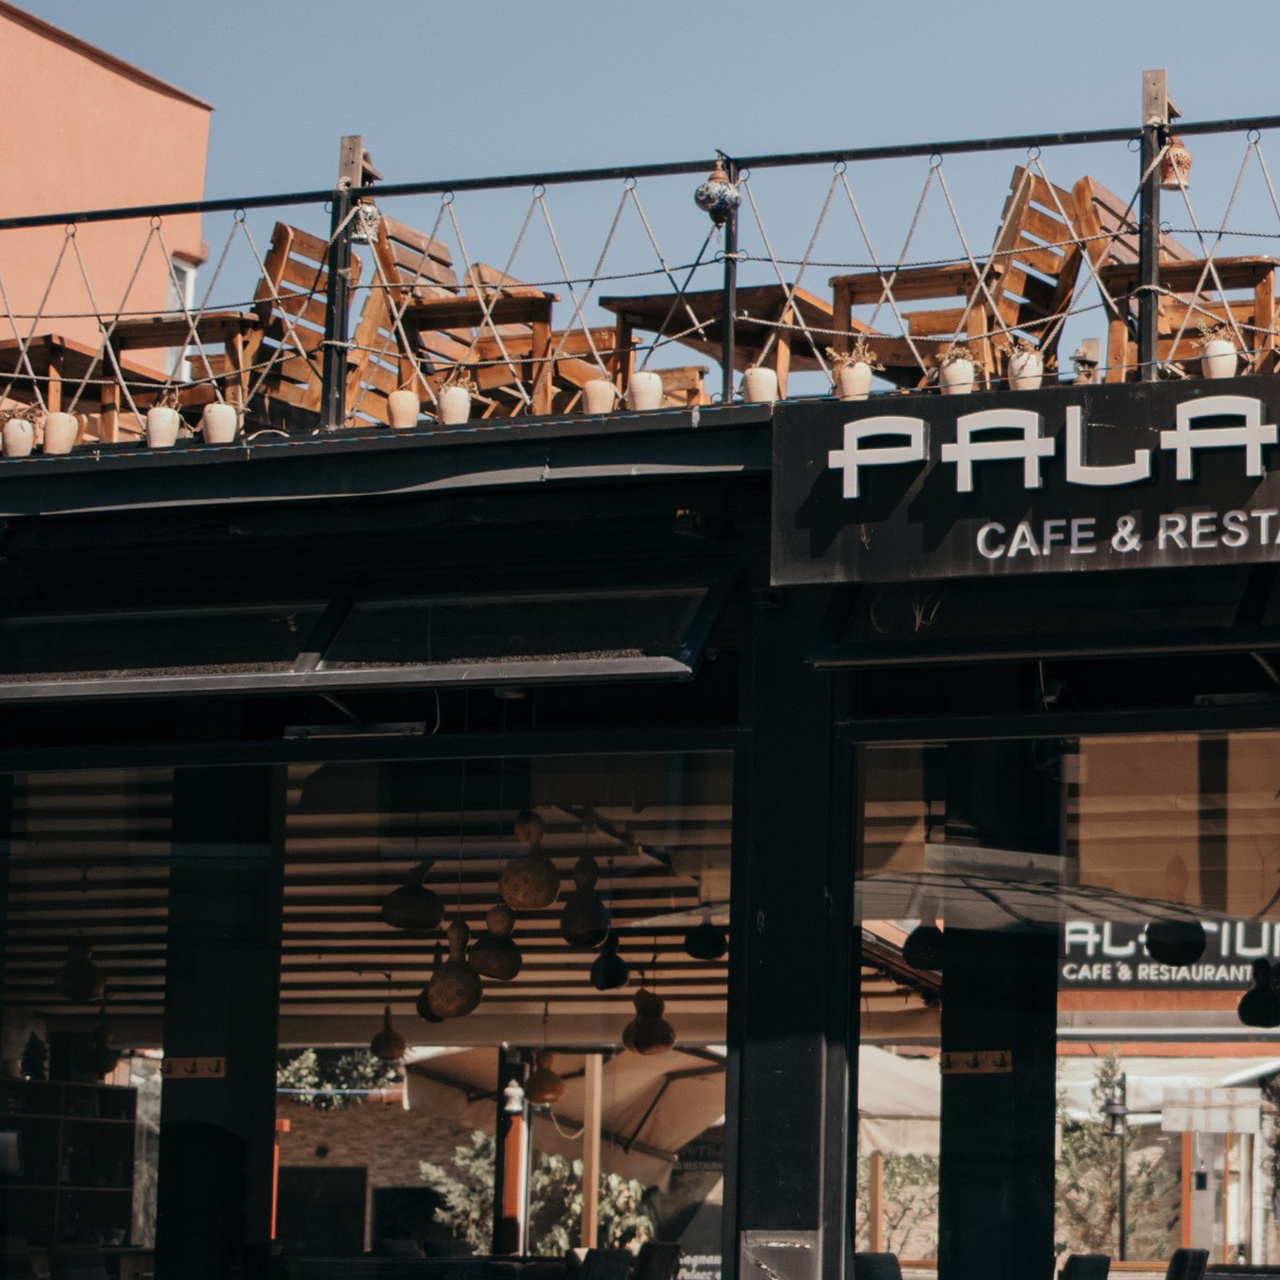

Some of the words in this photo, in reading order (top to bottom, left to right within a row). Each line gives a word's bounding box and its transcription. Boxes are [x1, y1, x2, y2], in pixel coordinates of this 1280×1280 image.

[976, 516, 1095, 561] CAFE
[1111, 514, 1142, 553] &
[1062, 963, 1112, 981] CAFE
[1116, 964, 1132, 981] &
[1138, 964, 1253, 982] RESTAURANT
